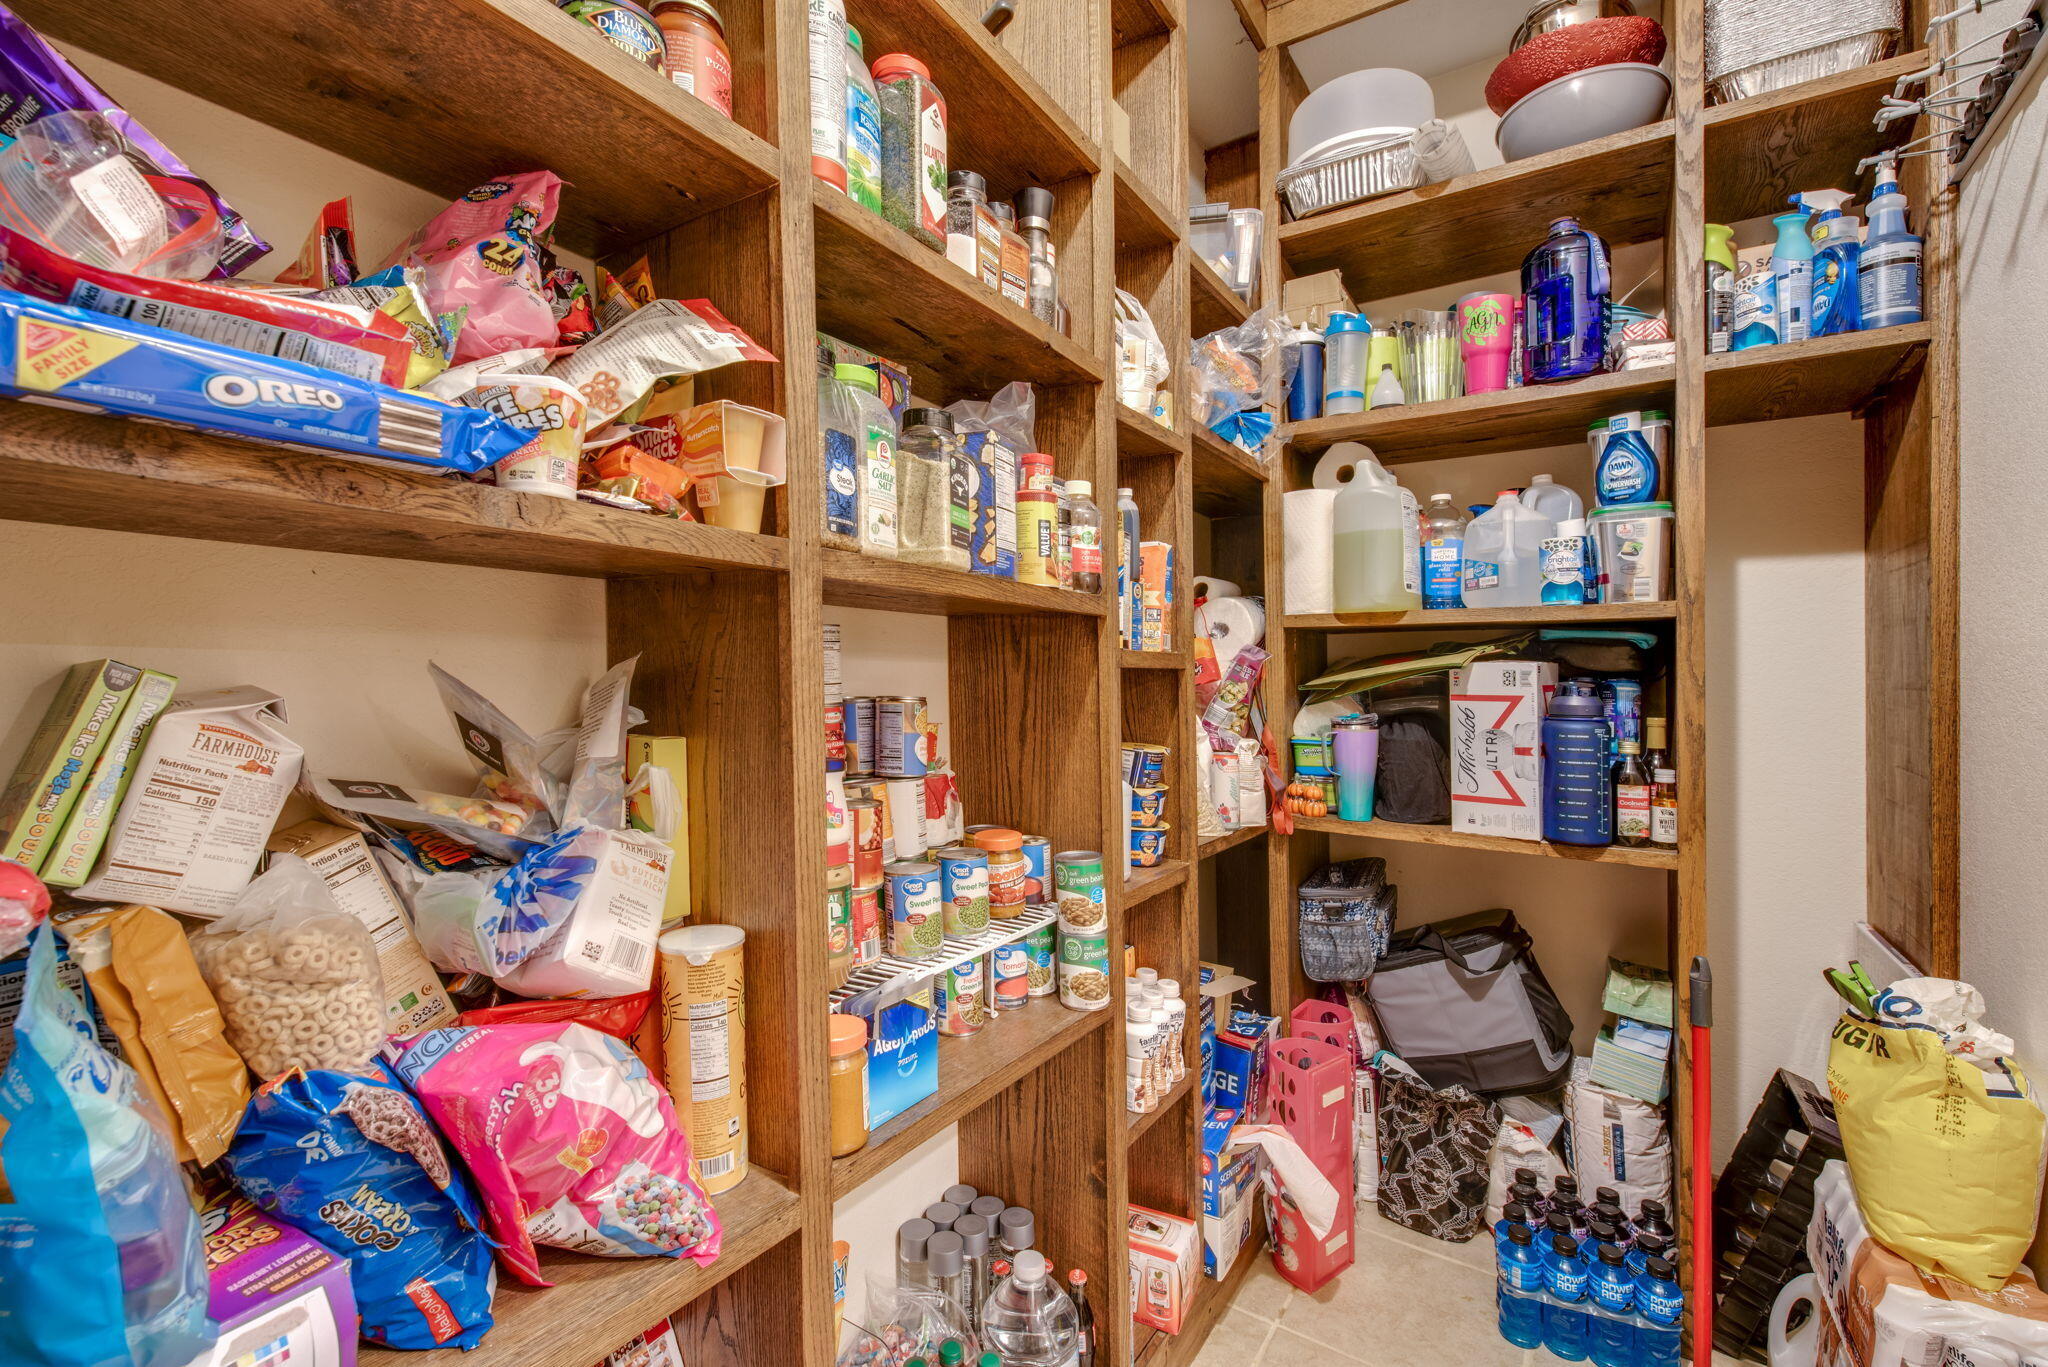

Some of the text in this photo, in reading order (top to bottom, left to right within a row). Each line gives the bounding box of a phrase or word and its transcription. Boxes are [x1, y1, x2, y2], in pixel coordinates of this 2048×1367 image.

[613, 9, 644, 34] BLUE
[597, 14, 656, 51] DIAMOND
[609, 37, 648, 63] BOLD
[1, 96, 41, 135] BROWNIE
[923, 143, 946, 163] CILANTRO
[484, 238, 525, 266] 24
[482, 257, 514, 276] COUNT
[141, 303, 160, 321] 100
[32, 337, 91, 375] FAMILY
[55, 355, 93, 380] SIZE
[206, 374, 344, 412] OREO
[635, 418, 678, 452] Snack
[686, 424, 721, 442] Butterscotch
[1607, 459, 1635, 473] DAWN
[836, 473, 854, 487] Steak
[871, 467, 896, 486] GARLIC
[1603, 477, 1641, 491] POWERWASH
[877, 481, 893, 493] SALT
[1040, 525, 1051, 556] VALUE
[191, 731, 281, 766] FARMHOUSE
[1457, 704, 1480, 794] Michelob
[1486, 728, 1499, 771] ULTRA
[152, 771, 174, 781] Serving
[158, 758, 229, 781] Nutrition Facts
[145, 786, 217, 808] Calories 150
[1659, 818, 1675, 826] WHITE
[338, 841, 361, 855] Facts
[620, 841, 669, 865] FARMHOUSE
[356, 861, 372, 873] 120
[952, 866, 970, 876] Great
[956, 870, 971, 878] Value
[642, 879, 664, 896] RICH
[905, 881, 923, 892] Great
[955, 882, 977, 892] Sweet
[1069, 876, 1090, 886] green
[626, 896, 649, 910] Artificial
[909, 900, 931, 909] Sweet
[1084, 951, 1100, 961] green
[956, 963, 973, 973] Great
[1002, 961, 1028, 971] Tomato
[689, 1000, 726, 1010] Nutrition Facts
[455, 1026, 495, 1054] CEREAL
[1602, 1125, 1611, 1158] HARVEST
[1219, 1163, 1242, 1186] SCENTED
[350, 1184, 411, 1233] CREAM
[319, 1199, 403, 1252] COOKIES
[226, 1241, 314, 1293] RASPBERRY LEMONADE
[242, 1248, 323, 1297] STRAWBERRY PEACH
[269, 1255, 333, 1293] ORANGE CHERRY
[1556, 1281, 1578, 1293] ADE
[1601, 1281, 1635, 1295] POWER
[1601, 1290, 1624, 1302] ADE
[1650, 1295, 1683, 1308] POWER
[1650, 1304, 1672, 1316] ADE
